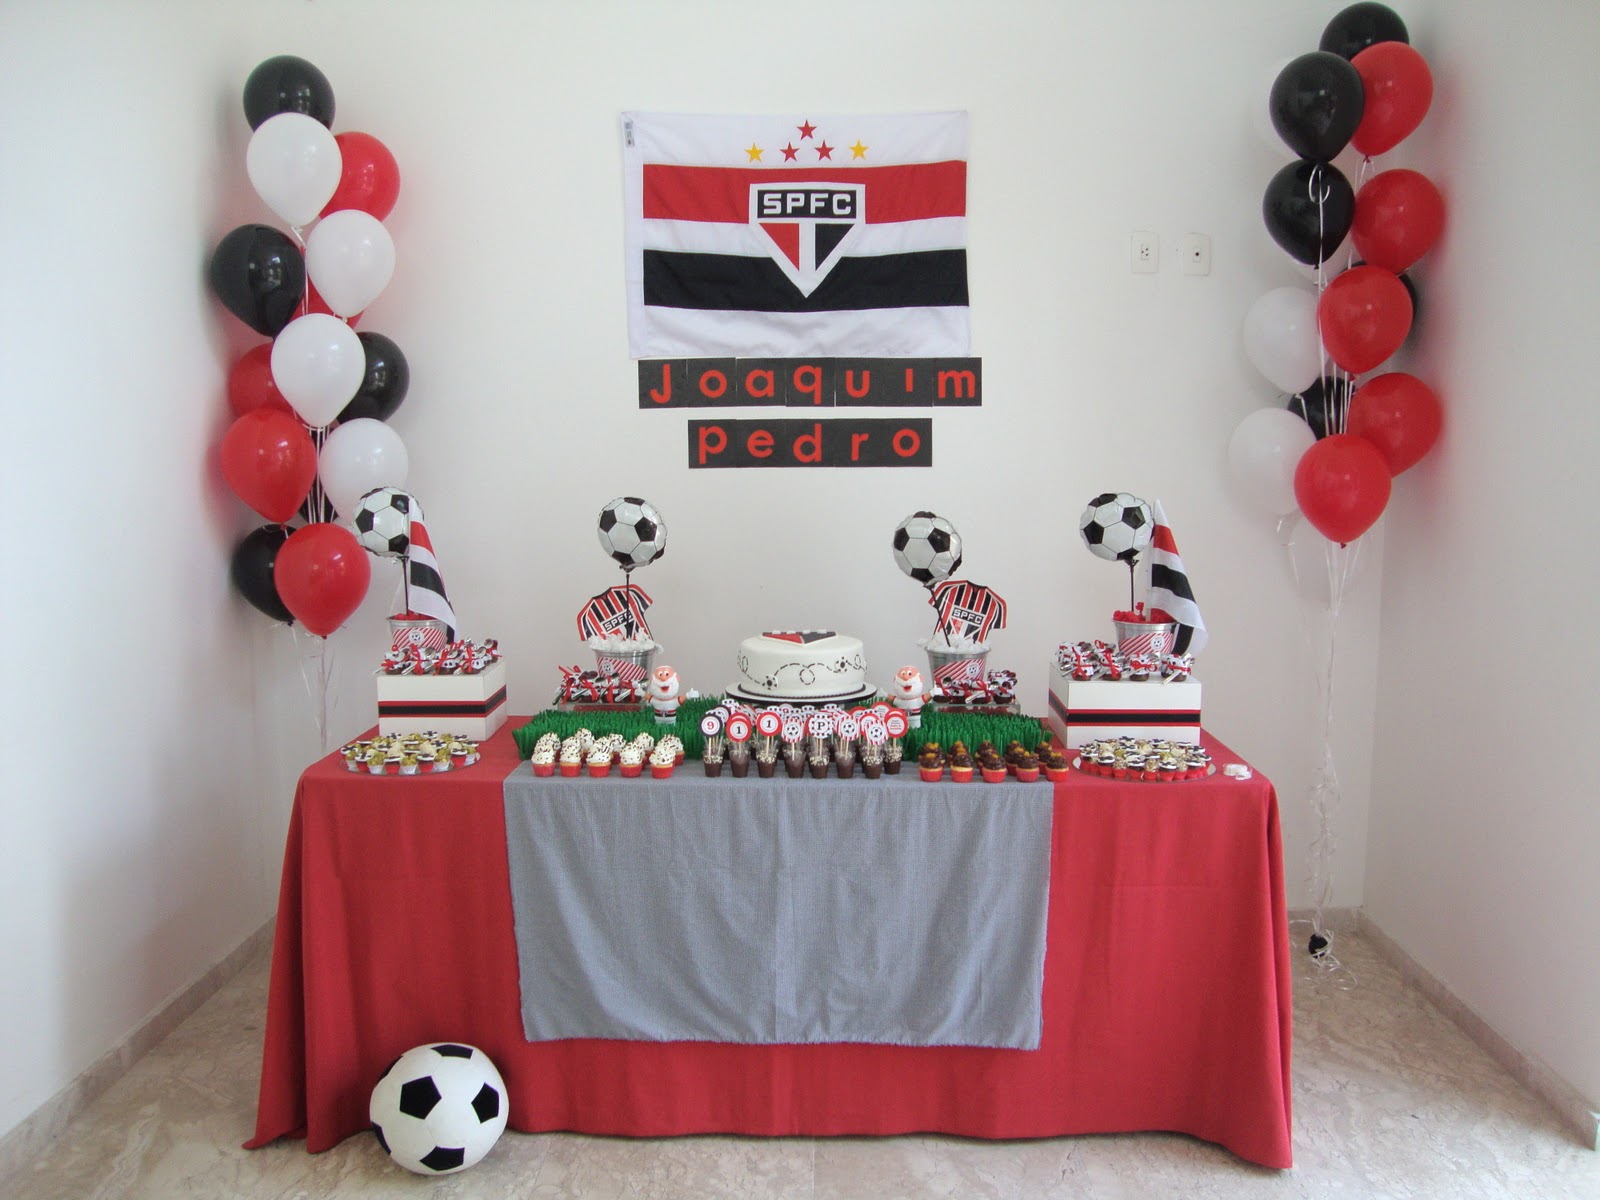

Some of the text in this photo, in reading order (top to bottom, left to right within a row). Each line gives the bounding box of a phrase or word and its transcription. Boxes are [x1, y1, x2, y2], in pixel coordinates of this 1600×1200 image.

[762, 192, 852, 215] SPFC
[953, 609, 982, 624] SPFC
[706, 721, 715, 730] 9
[766, 720, 772, 728] 1
[817, 721, 826, 731] P
[736, 726, 742, 735] 1
